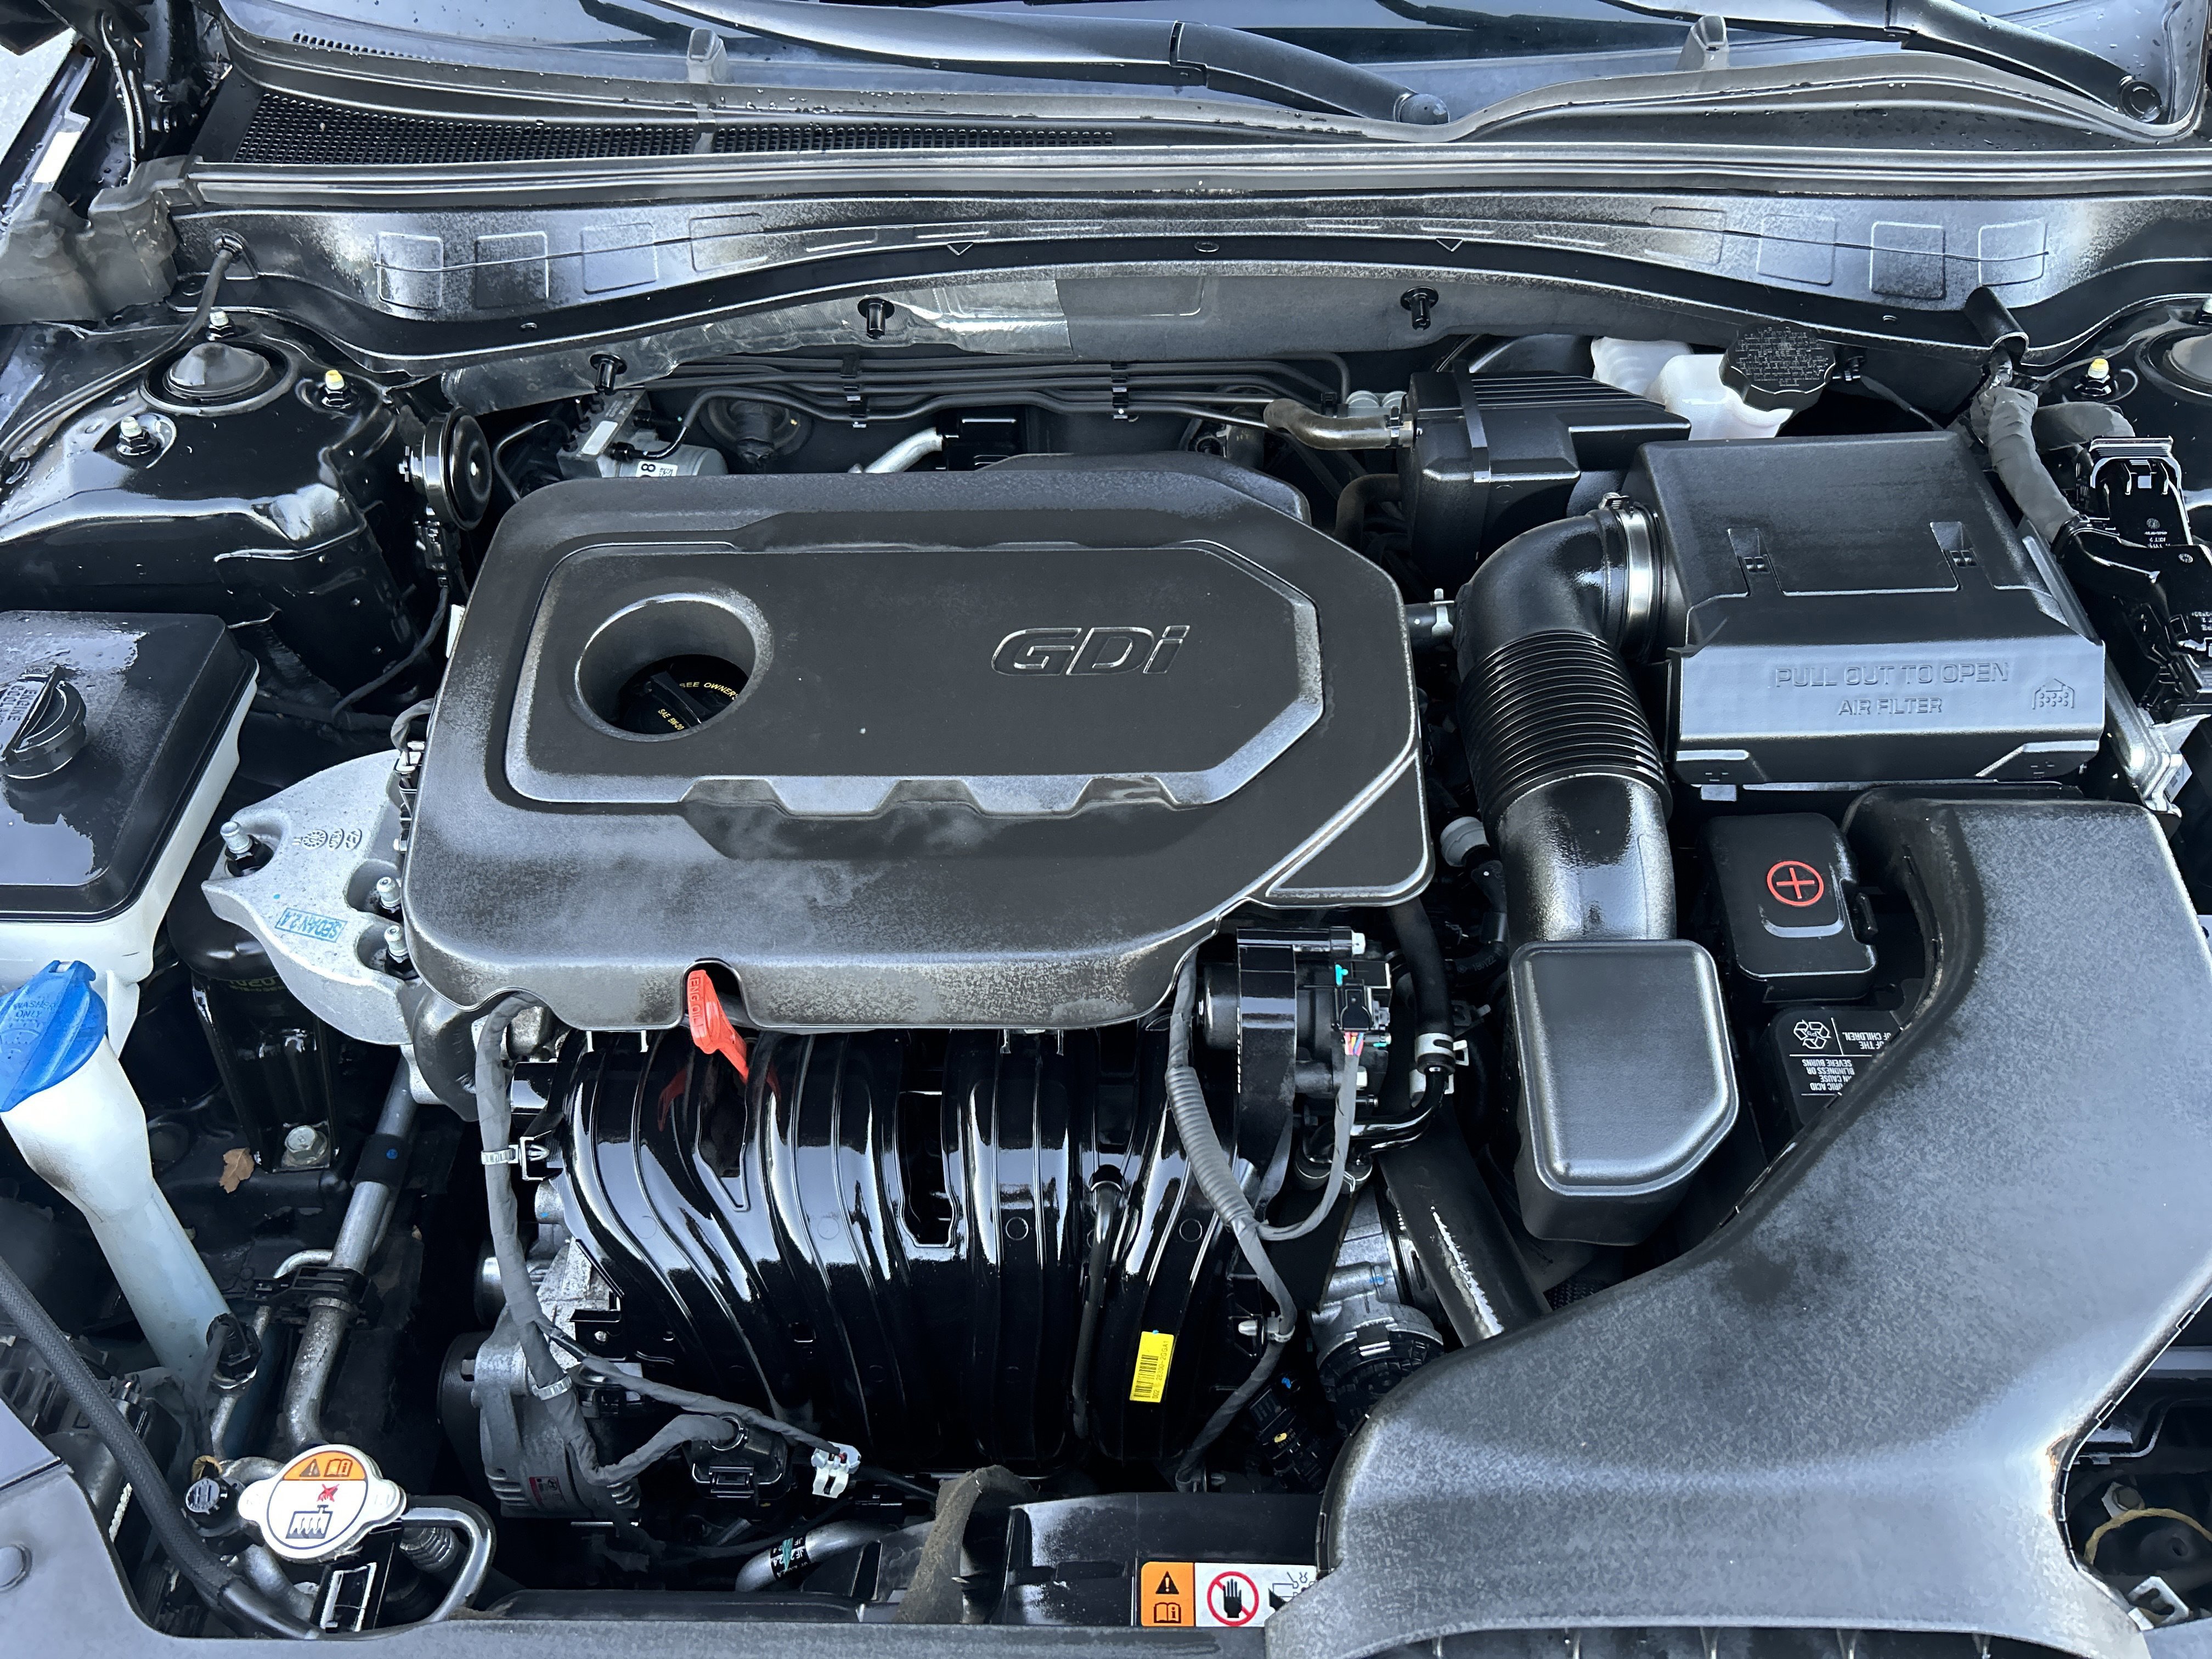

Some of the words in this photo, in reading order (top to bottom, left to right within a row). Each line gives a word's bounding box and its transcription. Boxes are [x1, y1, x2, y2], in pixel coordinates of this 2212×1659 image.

[991, 624, 1190, 676] GDi
[1775, 667, 1837, 687] PULL
[1844, 665, 1895, 685] OUT
[1900, 664, 1933, 685] TO
[1941, 662, 2008, 683] OPEN
[1838, 699, 1871, 716] AIR
[1877, 697, 1943, 715] FILTER
[658, 708, 671, 719] SAE
[667, 718, 684, 731] 5W-20
[690, 977, 701, 1001] ENG
[691, 1005, 702, 1024] OIL
[1842, 1032, 1882, 1041] CHILDREN.
[1858, 1041, 1875, 1049] THE
[1816, 1067, 1855, 1075] BLINDNESS
[1810, 1082, 1826, 1091] ACID
